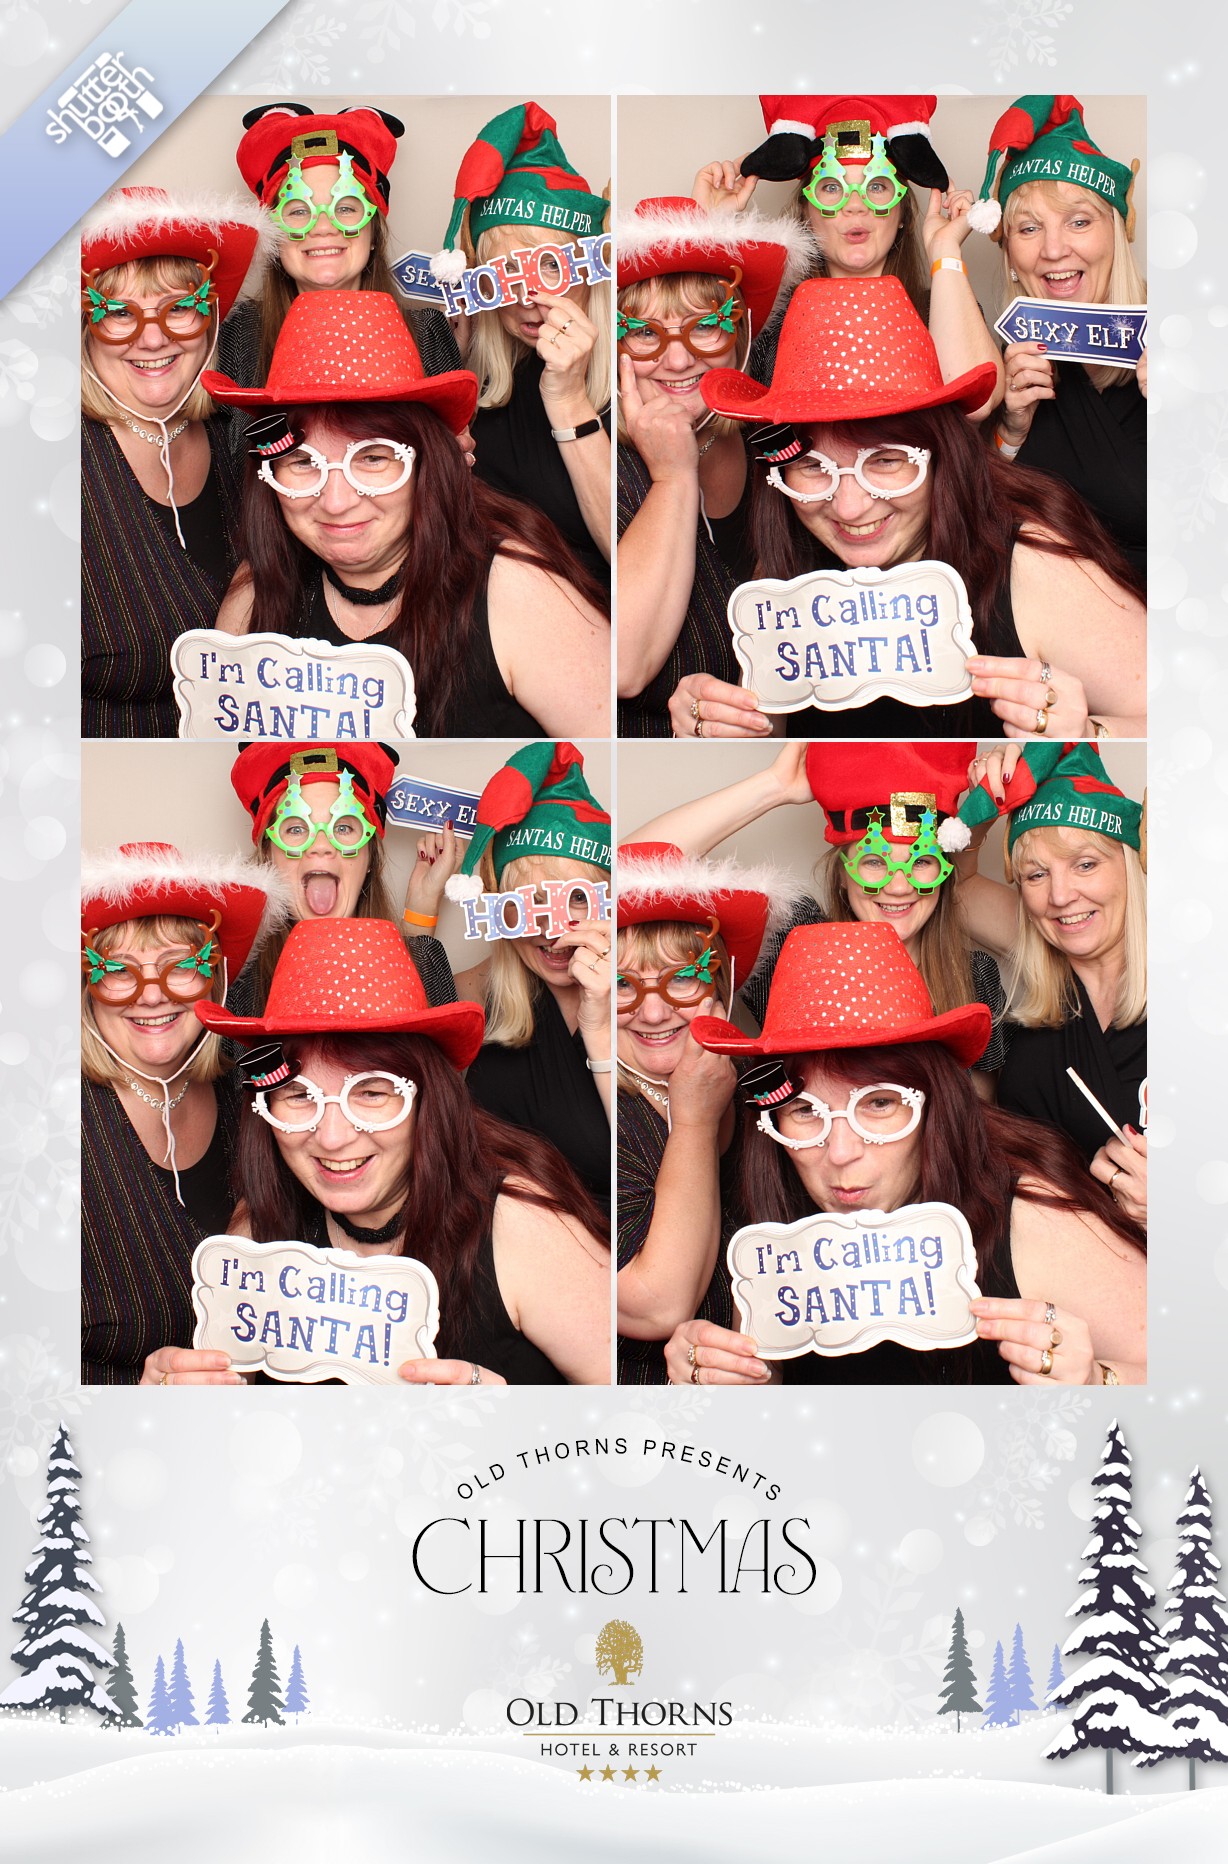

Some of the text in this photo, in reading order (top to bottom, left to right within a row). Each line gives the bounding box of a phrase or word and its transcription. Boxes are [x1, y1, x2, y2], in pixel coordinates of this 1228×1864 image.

[1010, 159, 1116, 197] SANTAS HELPER
[480, 198, 592, 233] SANTAS HELPER
[1014, 316, 1135, 349] SEXY ELF
[755, 590, 939, 630] I'm Calling
[775, 629, 932, 681] SANTA!
[200, 652, 384, 709] I'm Calling
[391, 789, 477, 825] SEXY EL
[1067, 805, 1122, 835] HELPER
[506, 828, 611, 866] SANTAS HELPE
[756, 1232, 943, 1275] I'm Calling
[220, 1258, 408, 1323] I'm Calling
[775, 1271, 936, 1326] SANTA!
[231, 1302, 391, 1366] SANTA!
